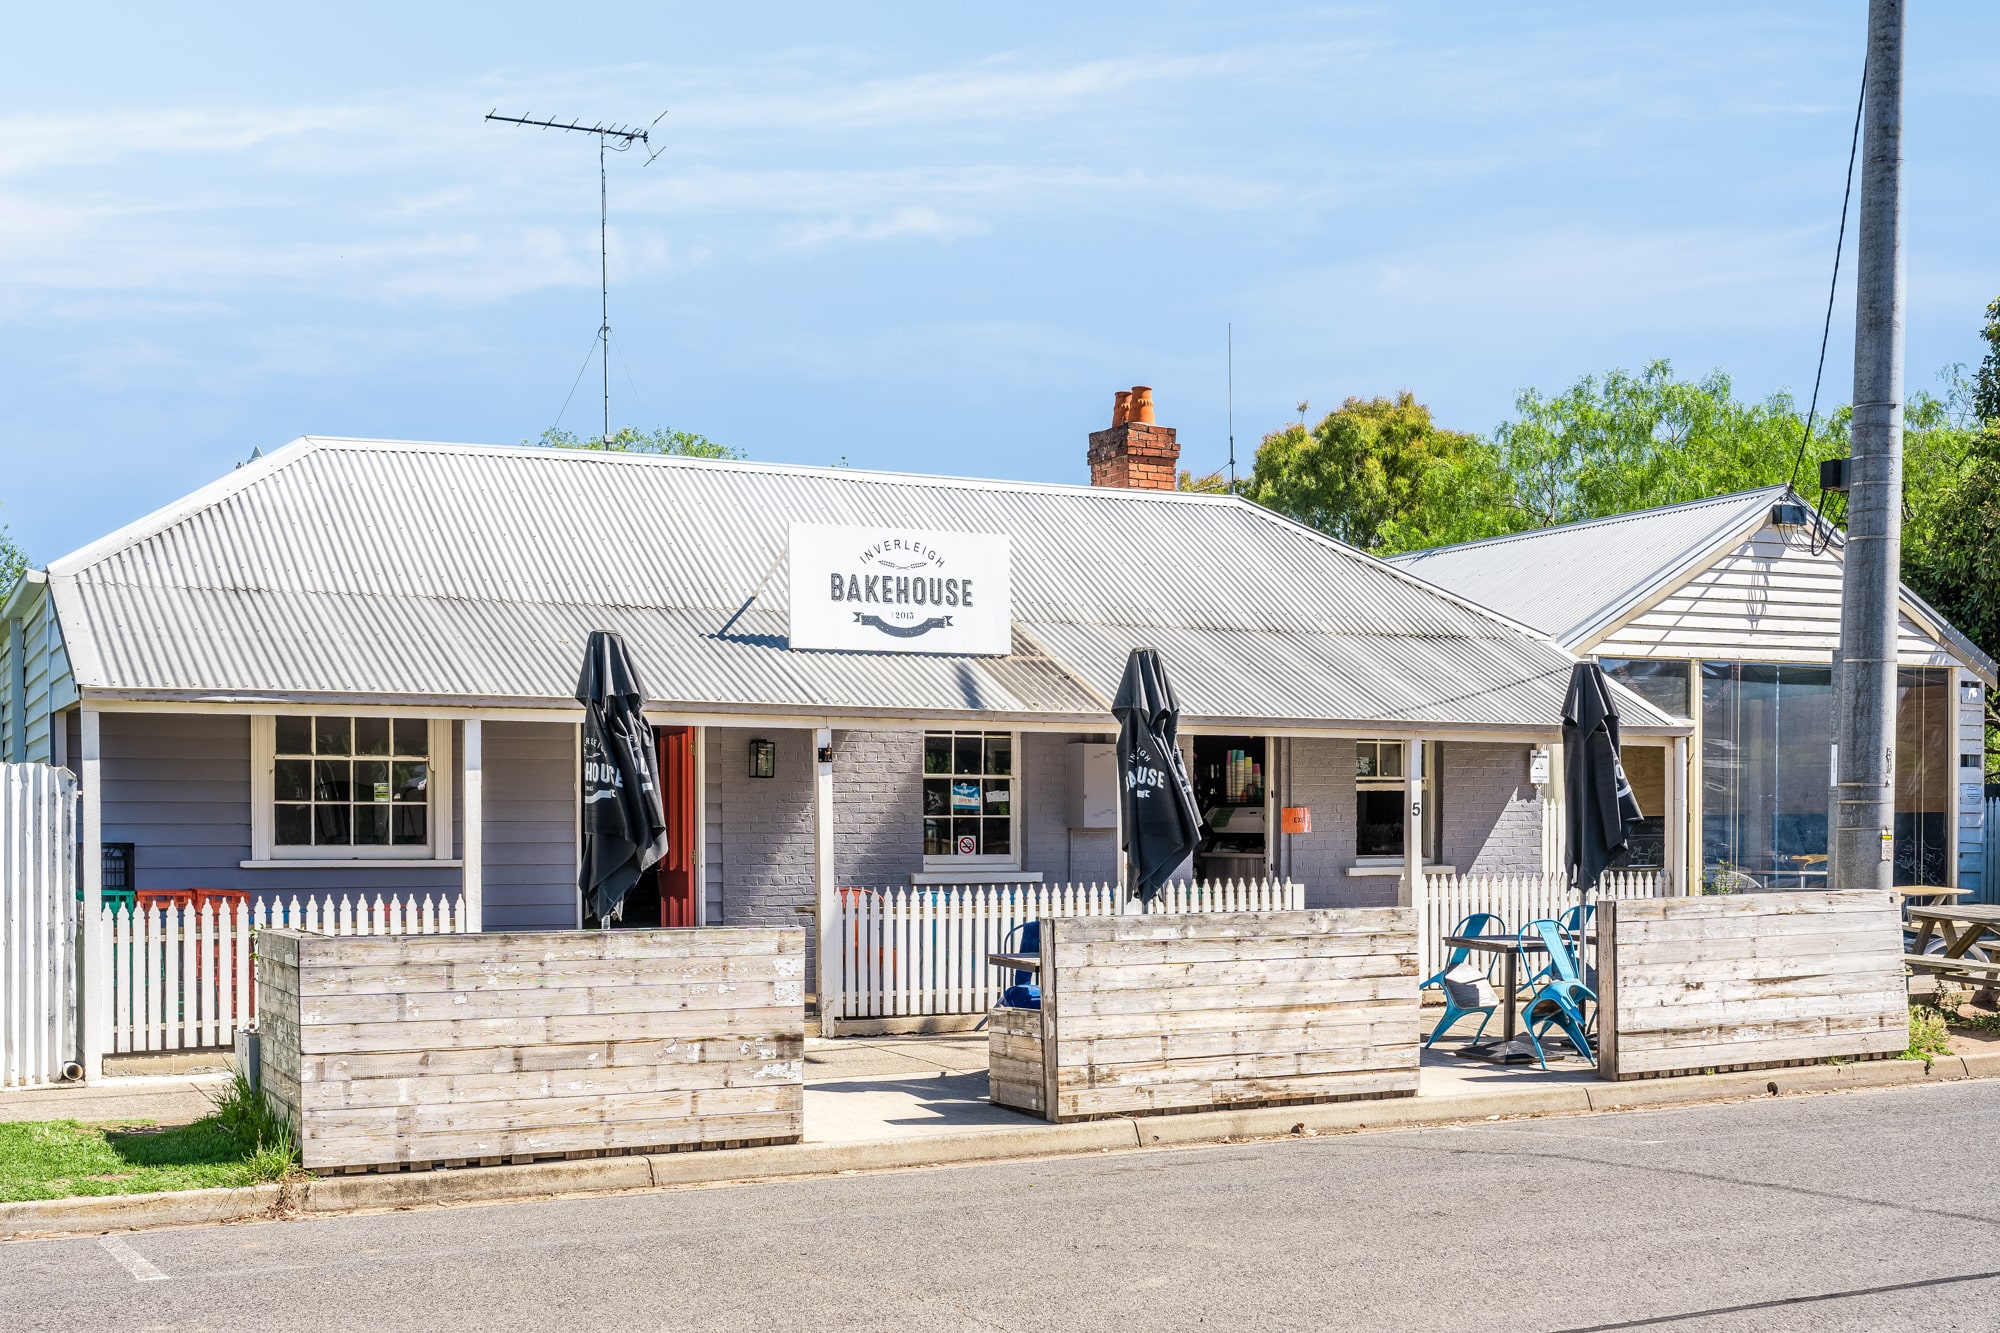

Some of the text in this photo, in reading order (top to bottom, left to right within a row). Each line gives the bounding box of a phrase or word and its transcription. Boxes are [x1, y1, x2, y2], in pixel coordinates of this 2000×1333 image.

[859, 539, 945, 568] INVERLEIGH
[830, 572, 973, 608] BAKEHOUSE
[1412, 802, 1421, 817] 5
